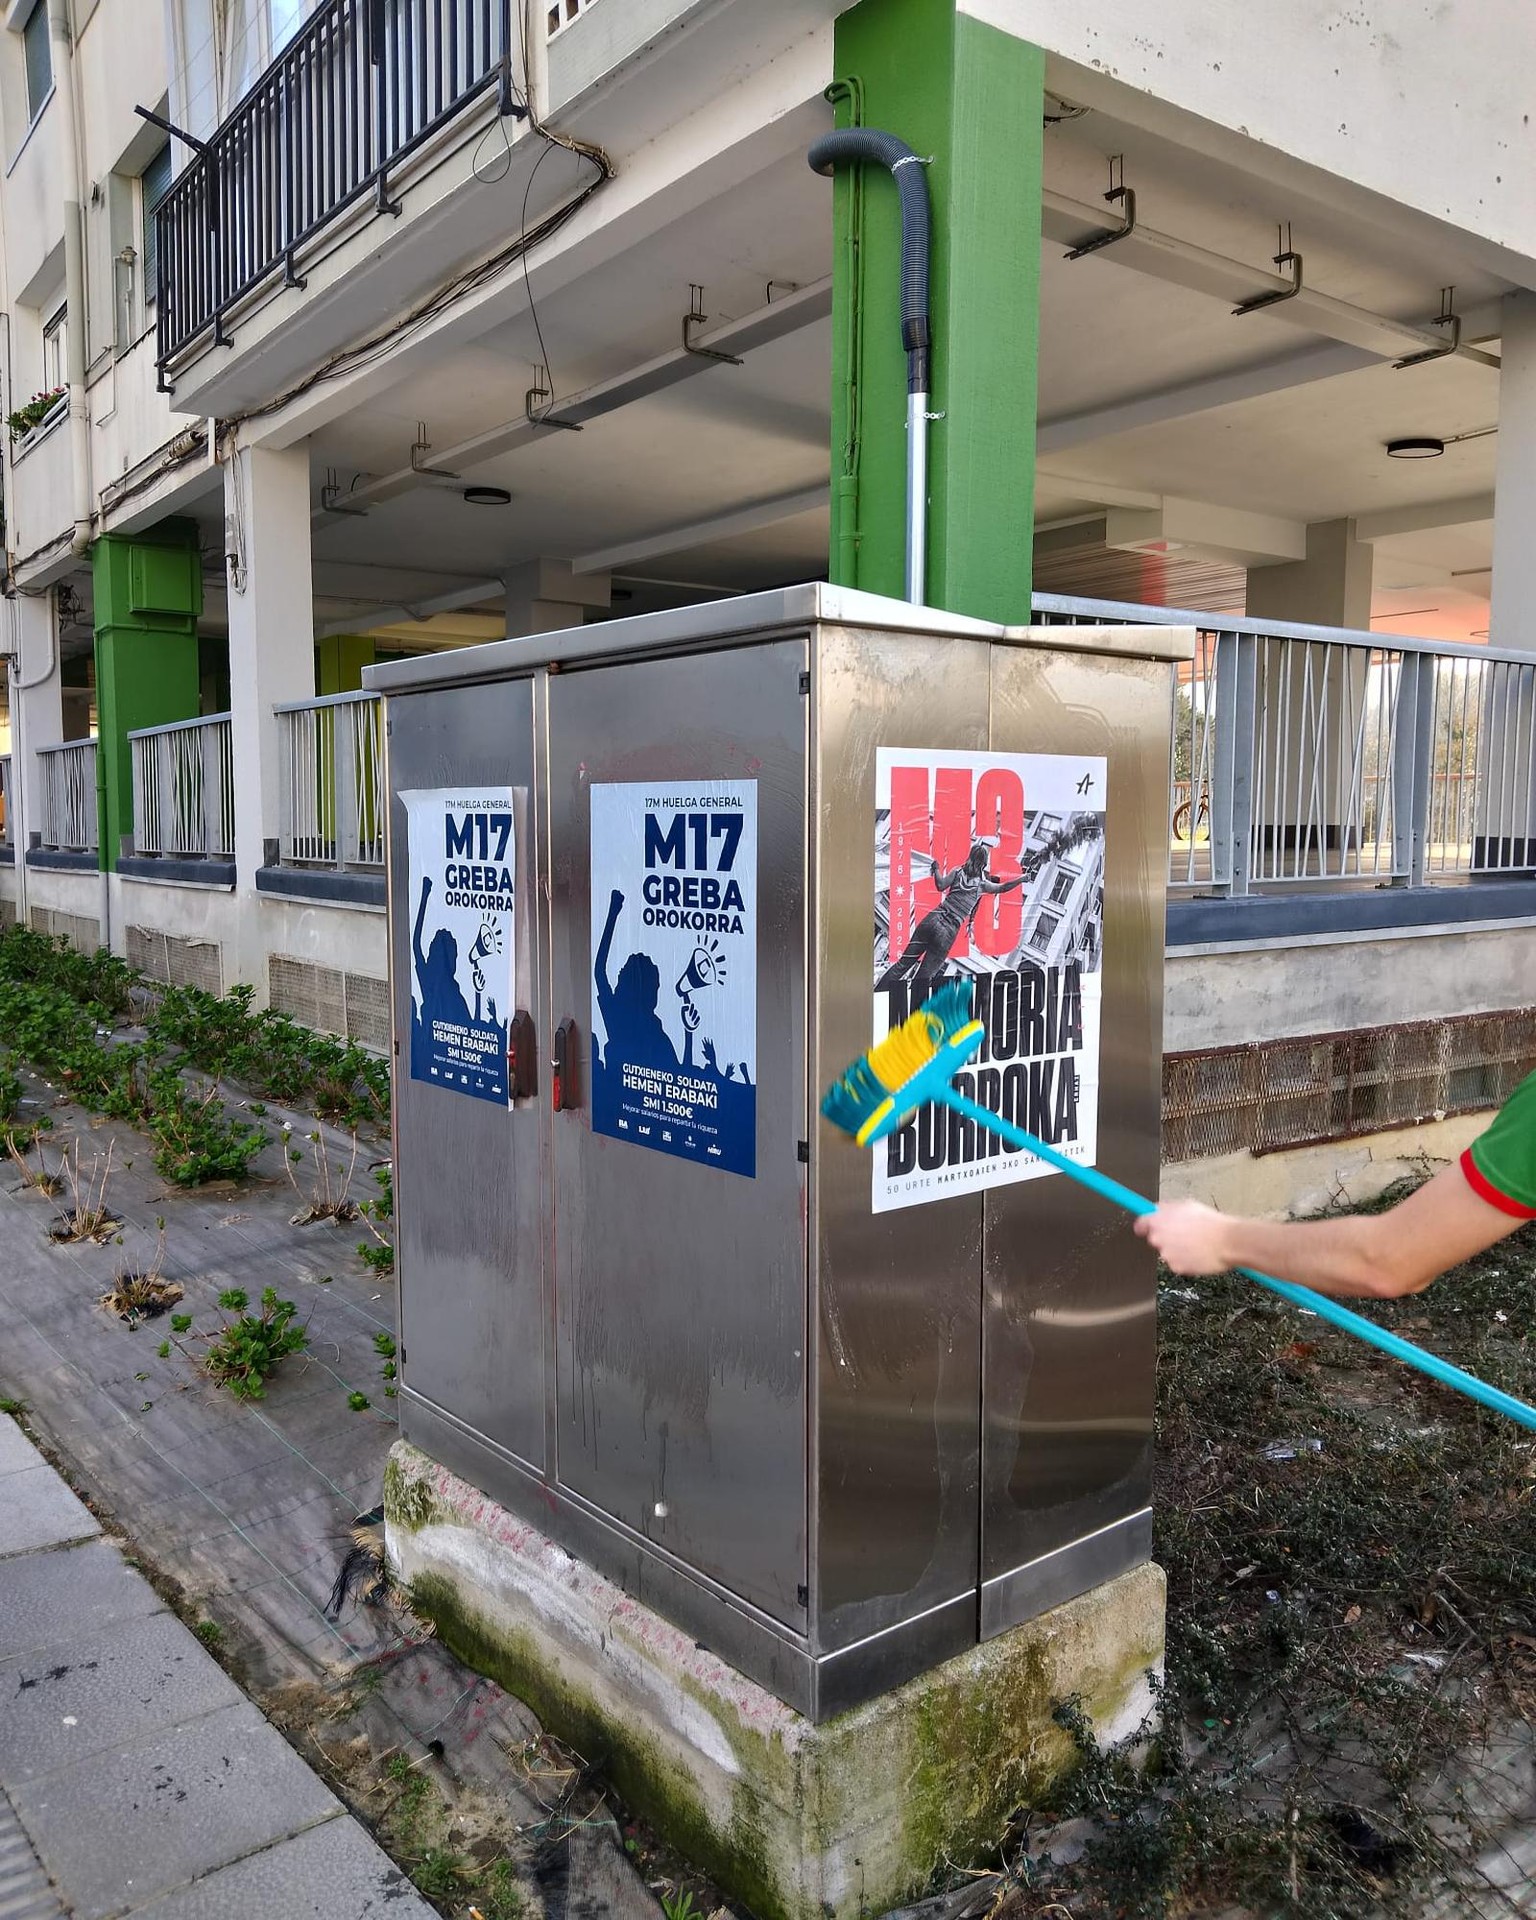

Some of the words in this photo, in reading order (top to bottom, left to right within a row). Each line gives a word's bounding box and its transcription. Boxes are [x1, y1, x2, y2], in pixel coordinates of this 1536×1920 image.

[445, 800, 456, 809] 17M
[456, 800, 481, 809] HUELGA
[482, 800, 512, 809] GENERAL
[645, 798, 660, 808] 17M
[662, 797, 698, 808] HUELGA
[699, 796, 743, 808] GENERAL
[445, 813, 513, 862] M17
[644, 813, 744, 872] M17
[445, 863, 514, 894] GREBA
[445, 891, 513, 912] OROKORRA
[642, 874, 746, 913] GREBA
[642, 907, 745, 935] OROKORRA
[432, 1020, 469, 1036] GUTXIENEKO
[470, 1028, 499, 1043] SOLDATA
[432, 1029, 461, 1047] HEMEN
[462, 1037, 499, 1055] ERABAKI
[447, 1047, 460, 1058] SMI
[622, 1063, 674, 1084] GUTXIENEKO
[677, 1074, 718, 1094] SOLDATA
[622, 1074, 662, 1096] HEMEN
[665, 1085, 718, 1109] ERABAKI
[642, 1096, 661, 1111] SMI
[661, 1100, 694, 1119] 1.500€
[887, 1184, 899, 1195] 50
[905, 1177, 931, 1191] URTE
[1002, 1160, 1019, 1170] 3KO
